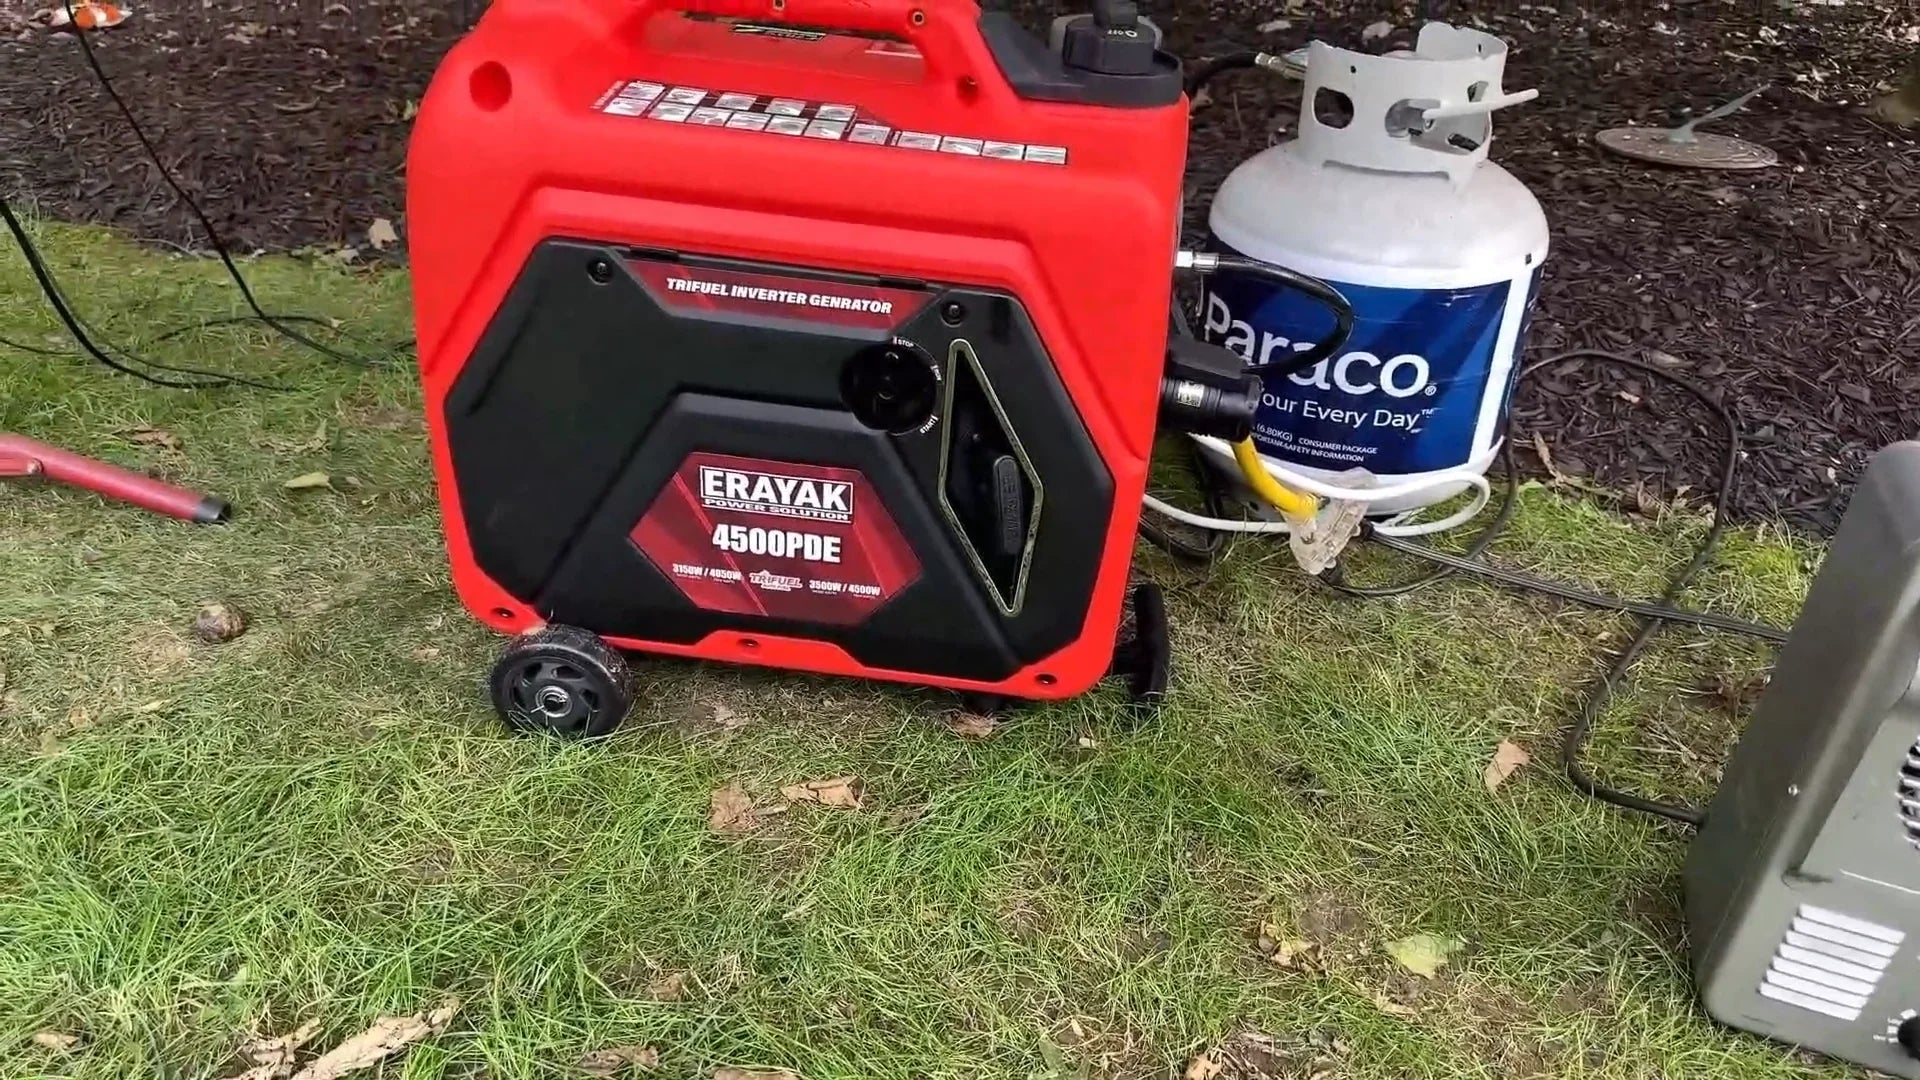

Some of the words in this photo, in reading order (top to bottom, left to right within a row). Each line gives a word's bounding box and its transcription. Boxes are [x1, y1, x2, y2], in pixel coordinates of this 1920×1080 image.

[667, 278, 729, 297] TRIFUEL
[731, 285, 807, 305] INVERTER
[809, 294, 892, 314] GENRATOR
[898, 338, 914, 348] STOP
[1261, 392, 1298, 413] our
[1303, 399, 1368, 428] Every
[1298, 437, 1341, 451] CONSUMER
[1342, 445, 1378, 455] PACKAGE
[1311, 448, 1364, 463] INFORMATION
[703, 469, 849, 512] ERAYAK
[704, 499, 767, 511] POWER
[770, 507, 849, 520] SOLUTION
[712, 523, 841, 563] 4500PDE
[672, 563, 703, 575] 3150W
[750, 573, 801, 587] TRIFUEL
[809, 579, 841, 592] 3500W
[848, 584, 880, 596] 4500W
